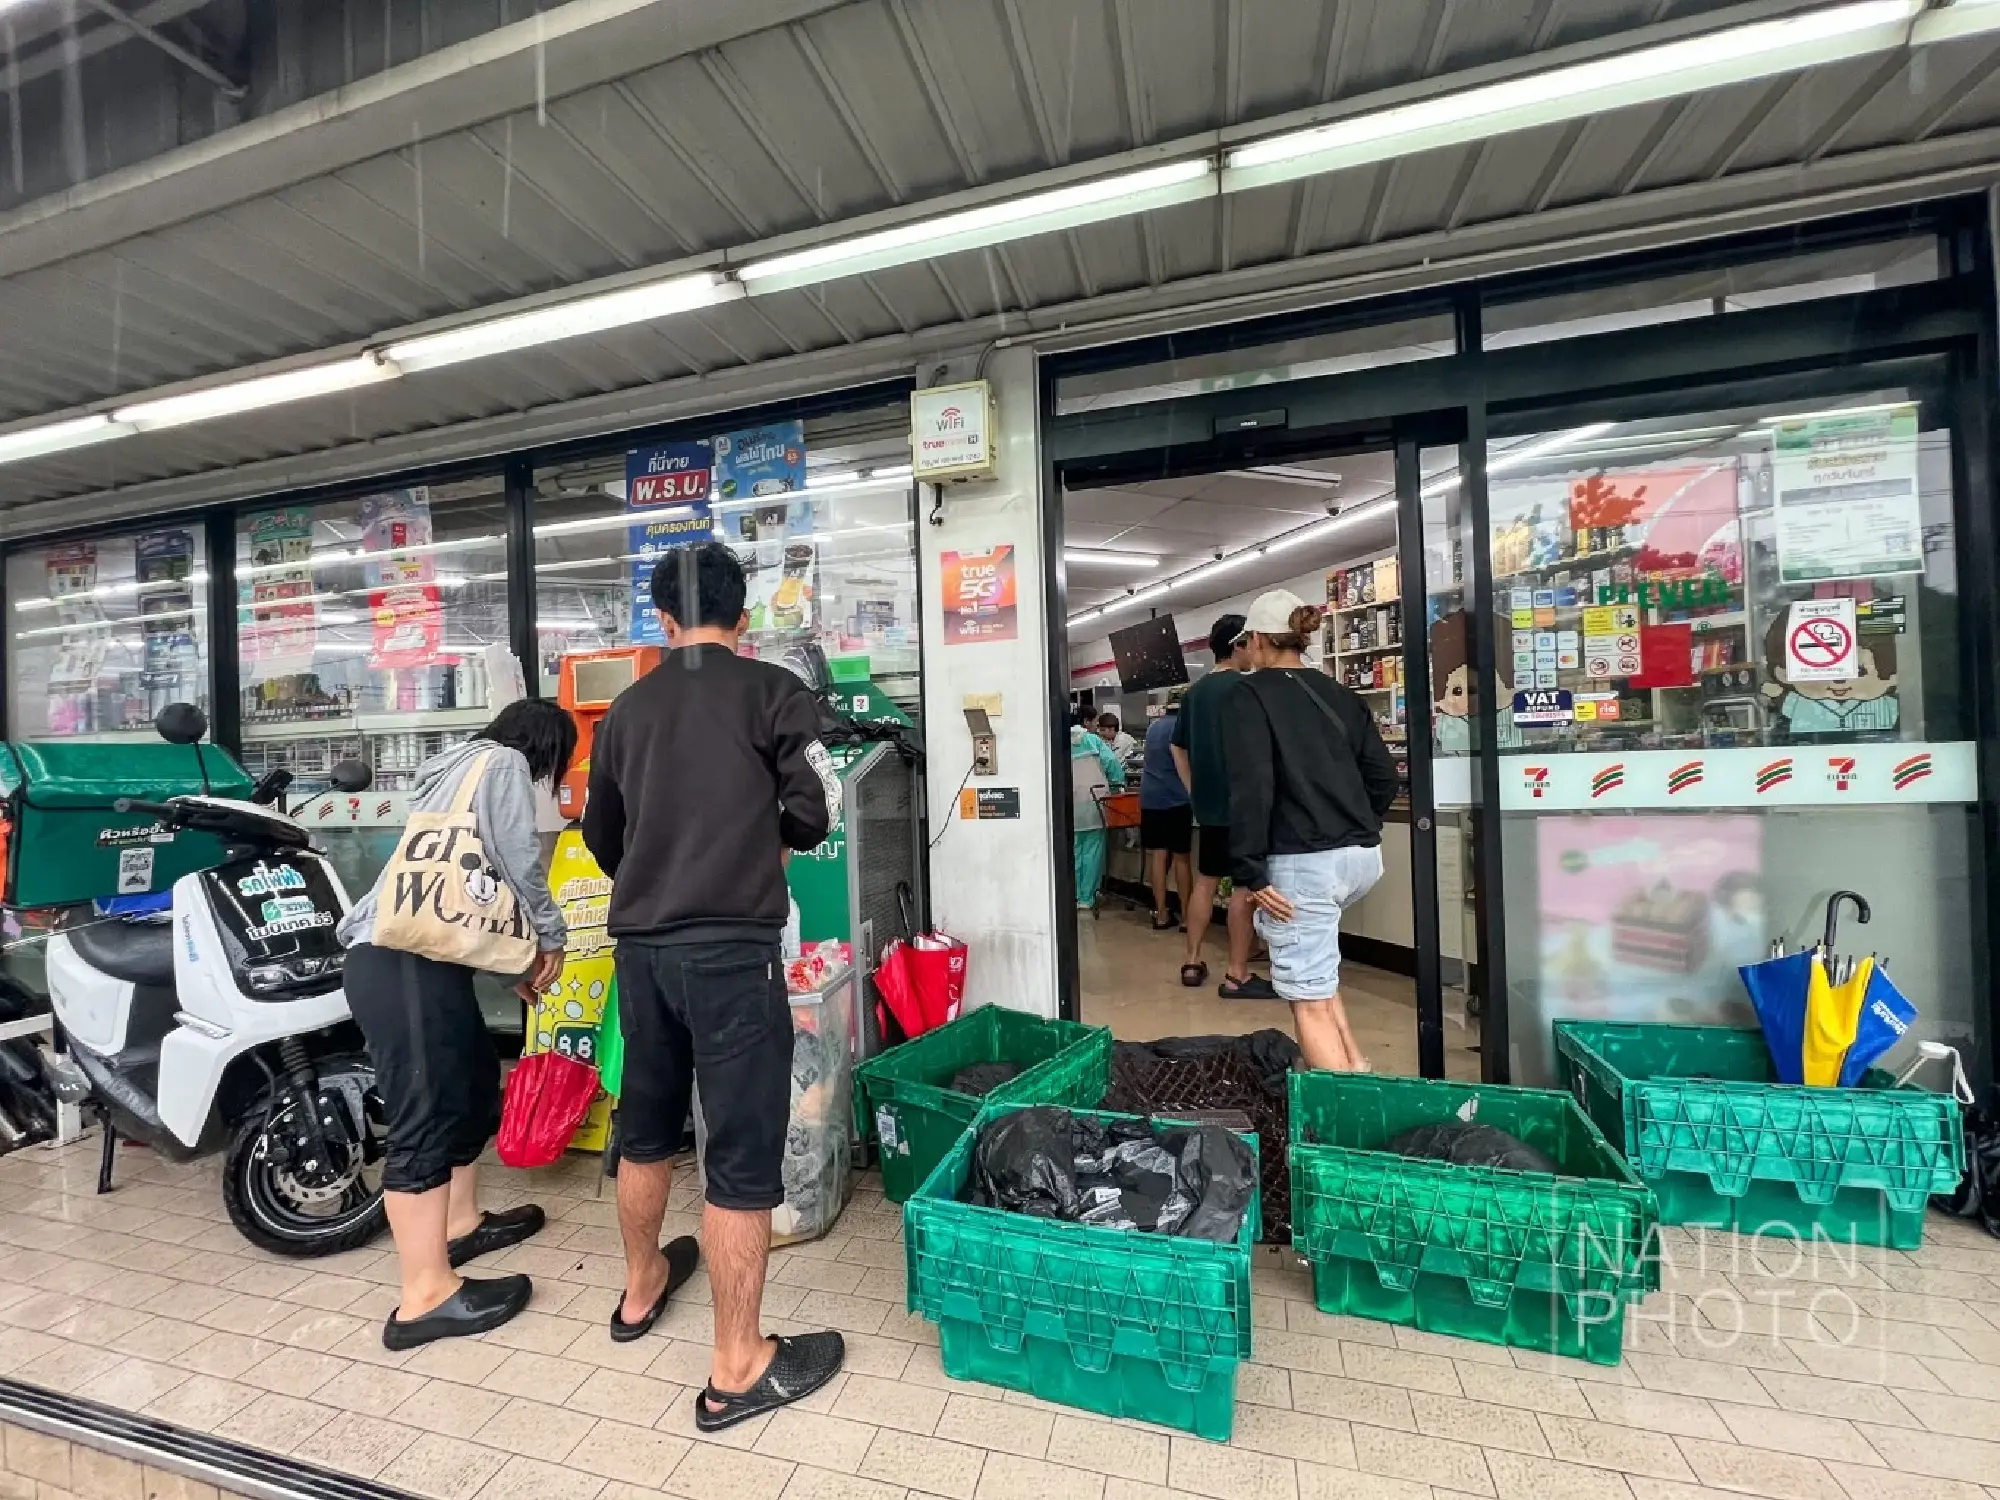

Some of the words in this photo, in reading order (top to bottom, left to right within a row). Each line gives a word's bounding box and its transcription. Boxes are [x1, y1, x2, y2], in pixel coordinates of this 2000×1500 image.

[960, 563, 996, 578] true
[959, 577, 997, 600] 5G
[1524, 691, 1559, 706] VAT
[239, 863, 307, 896] รถไฟฟ้า
